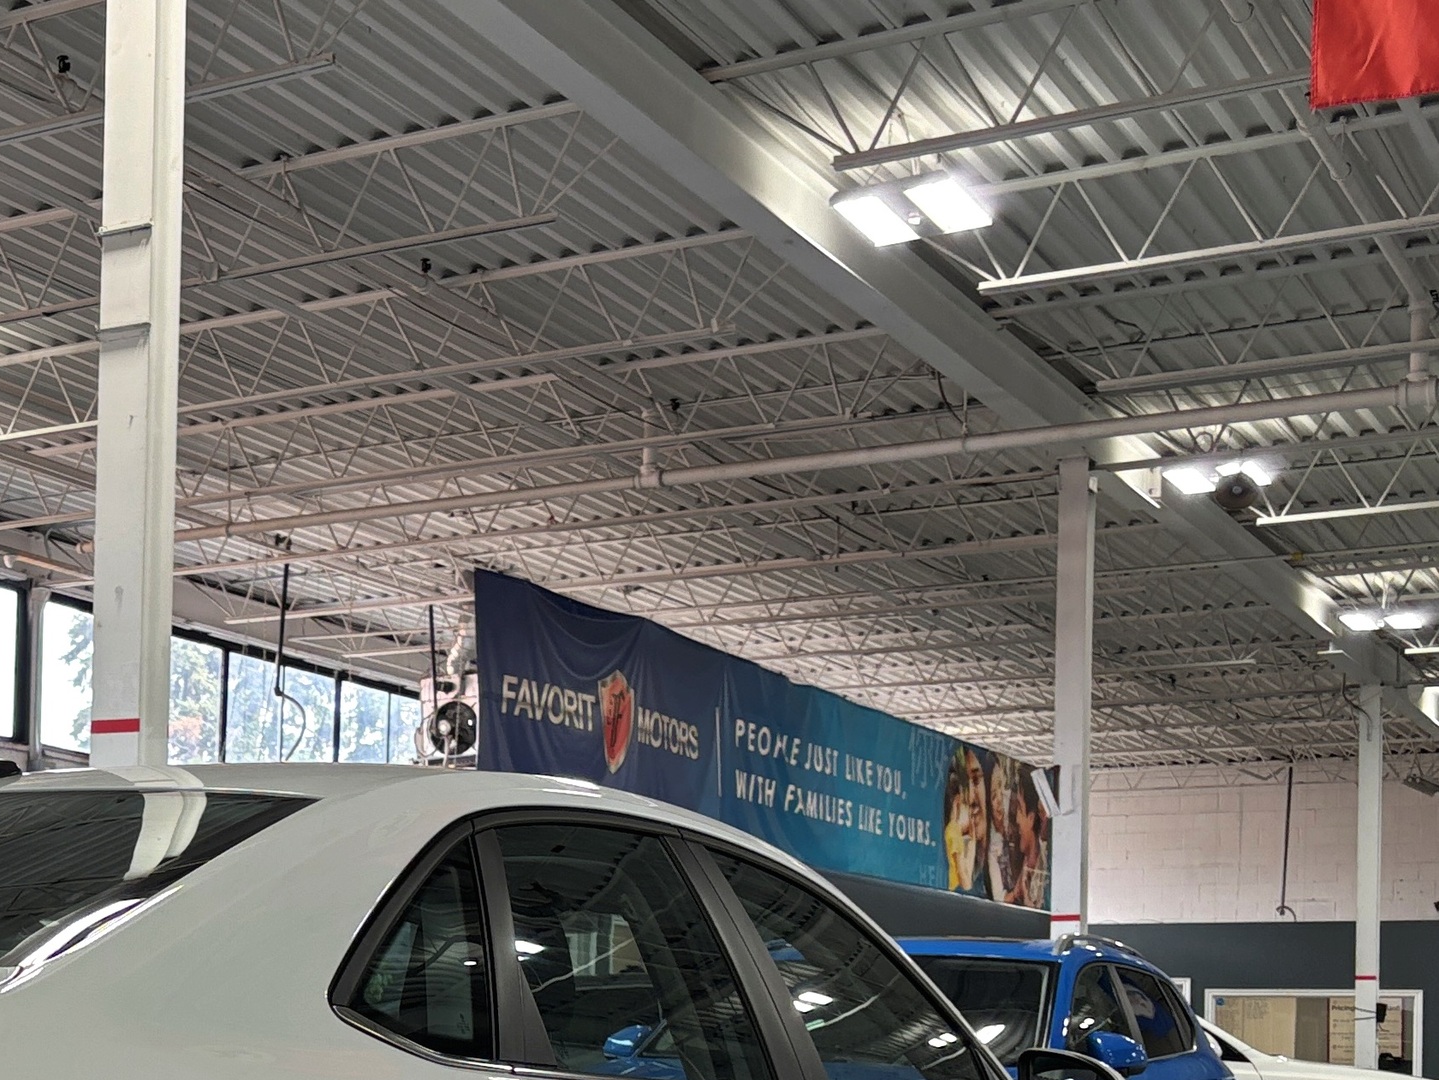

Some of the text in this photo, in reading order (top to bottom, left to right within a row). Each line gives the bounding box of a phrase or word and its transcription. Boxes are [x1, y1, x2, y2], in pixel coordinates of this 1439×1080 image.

[501, 674, 597, 732] FAVORIT
[637, 706, 699, 760] MOTORS
[804, 742, 840, 777] JUST
[845, 753, 873, 787] LIKE
[735, 768, 937, 848] WITH FAMILIES LIKE YOURS.
